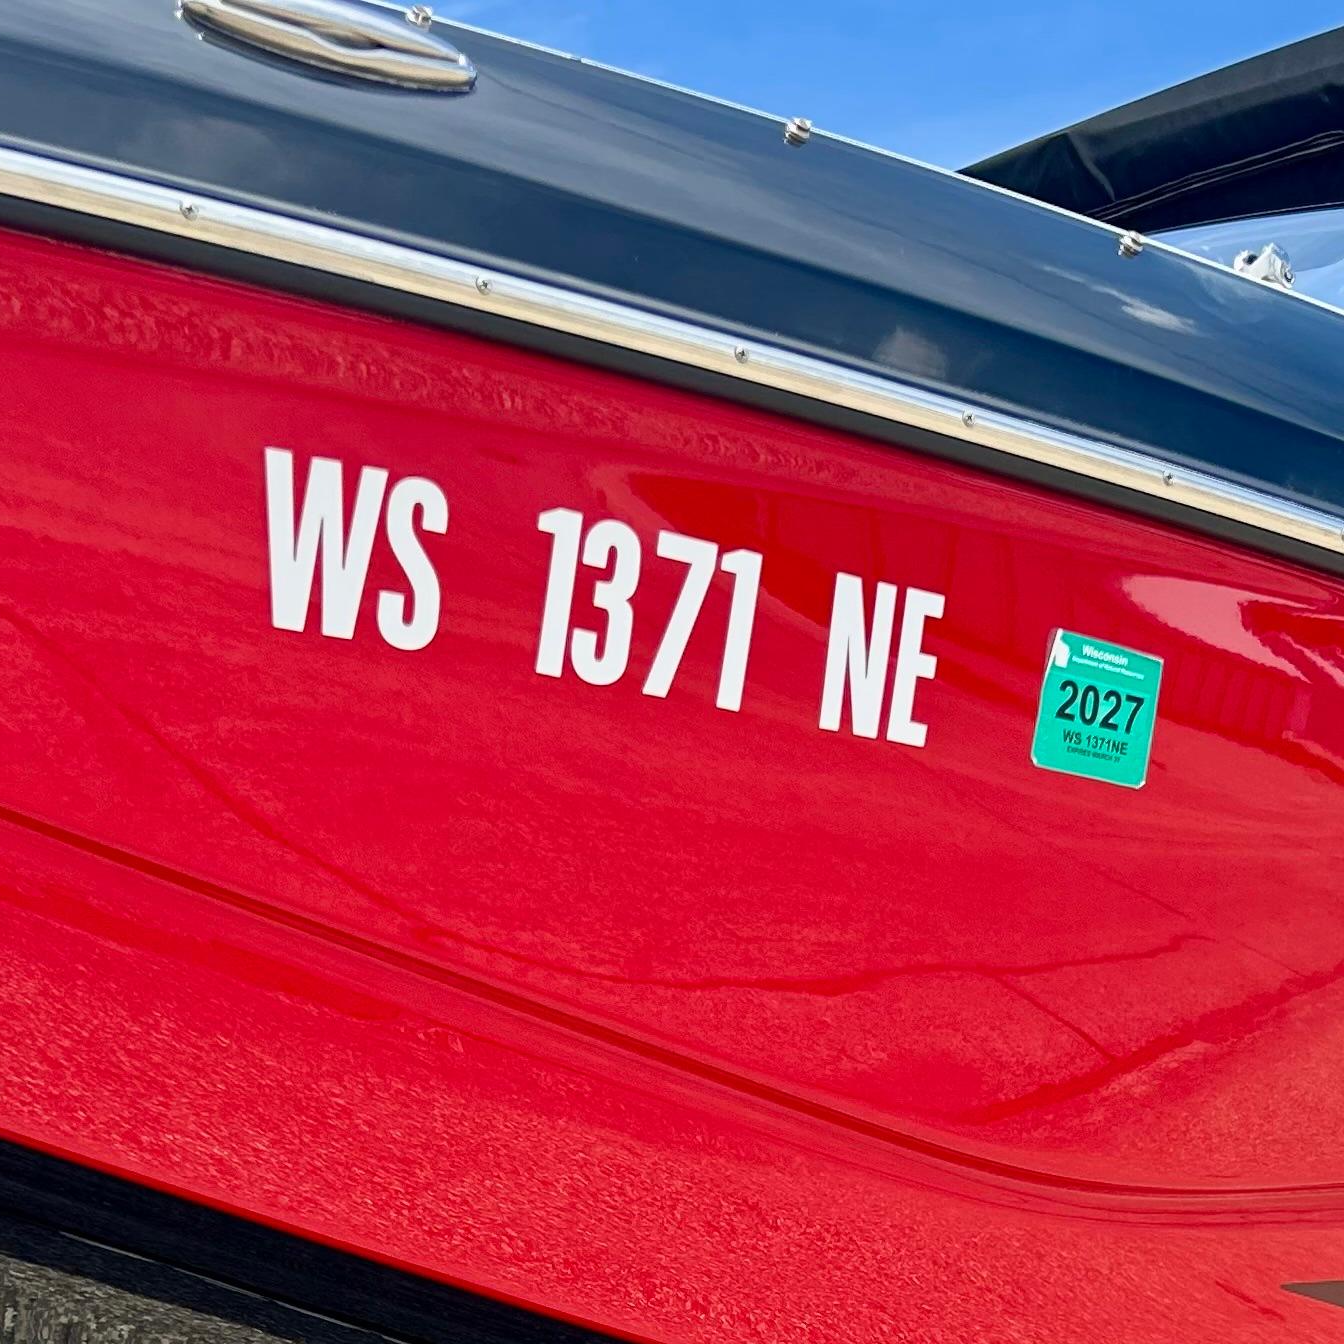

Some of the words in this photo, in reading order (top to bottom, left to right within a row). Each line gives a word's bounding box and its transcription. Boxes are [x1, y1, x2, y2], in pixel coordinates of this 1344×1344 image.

[264, 446, 449, 651] WS
[536, 506, 763, 713] 1371
[818, 571, 946, 748] NE
[1082, 644, 1129, 667] Wisconsin
[1055, 680, 1145, 735] 2027
[1063, 728, 1082, 745] WS
[1086, 734, 1129, 756] 1371NE
